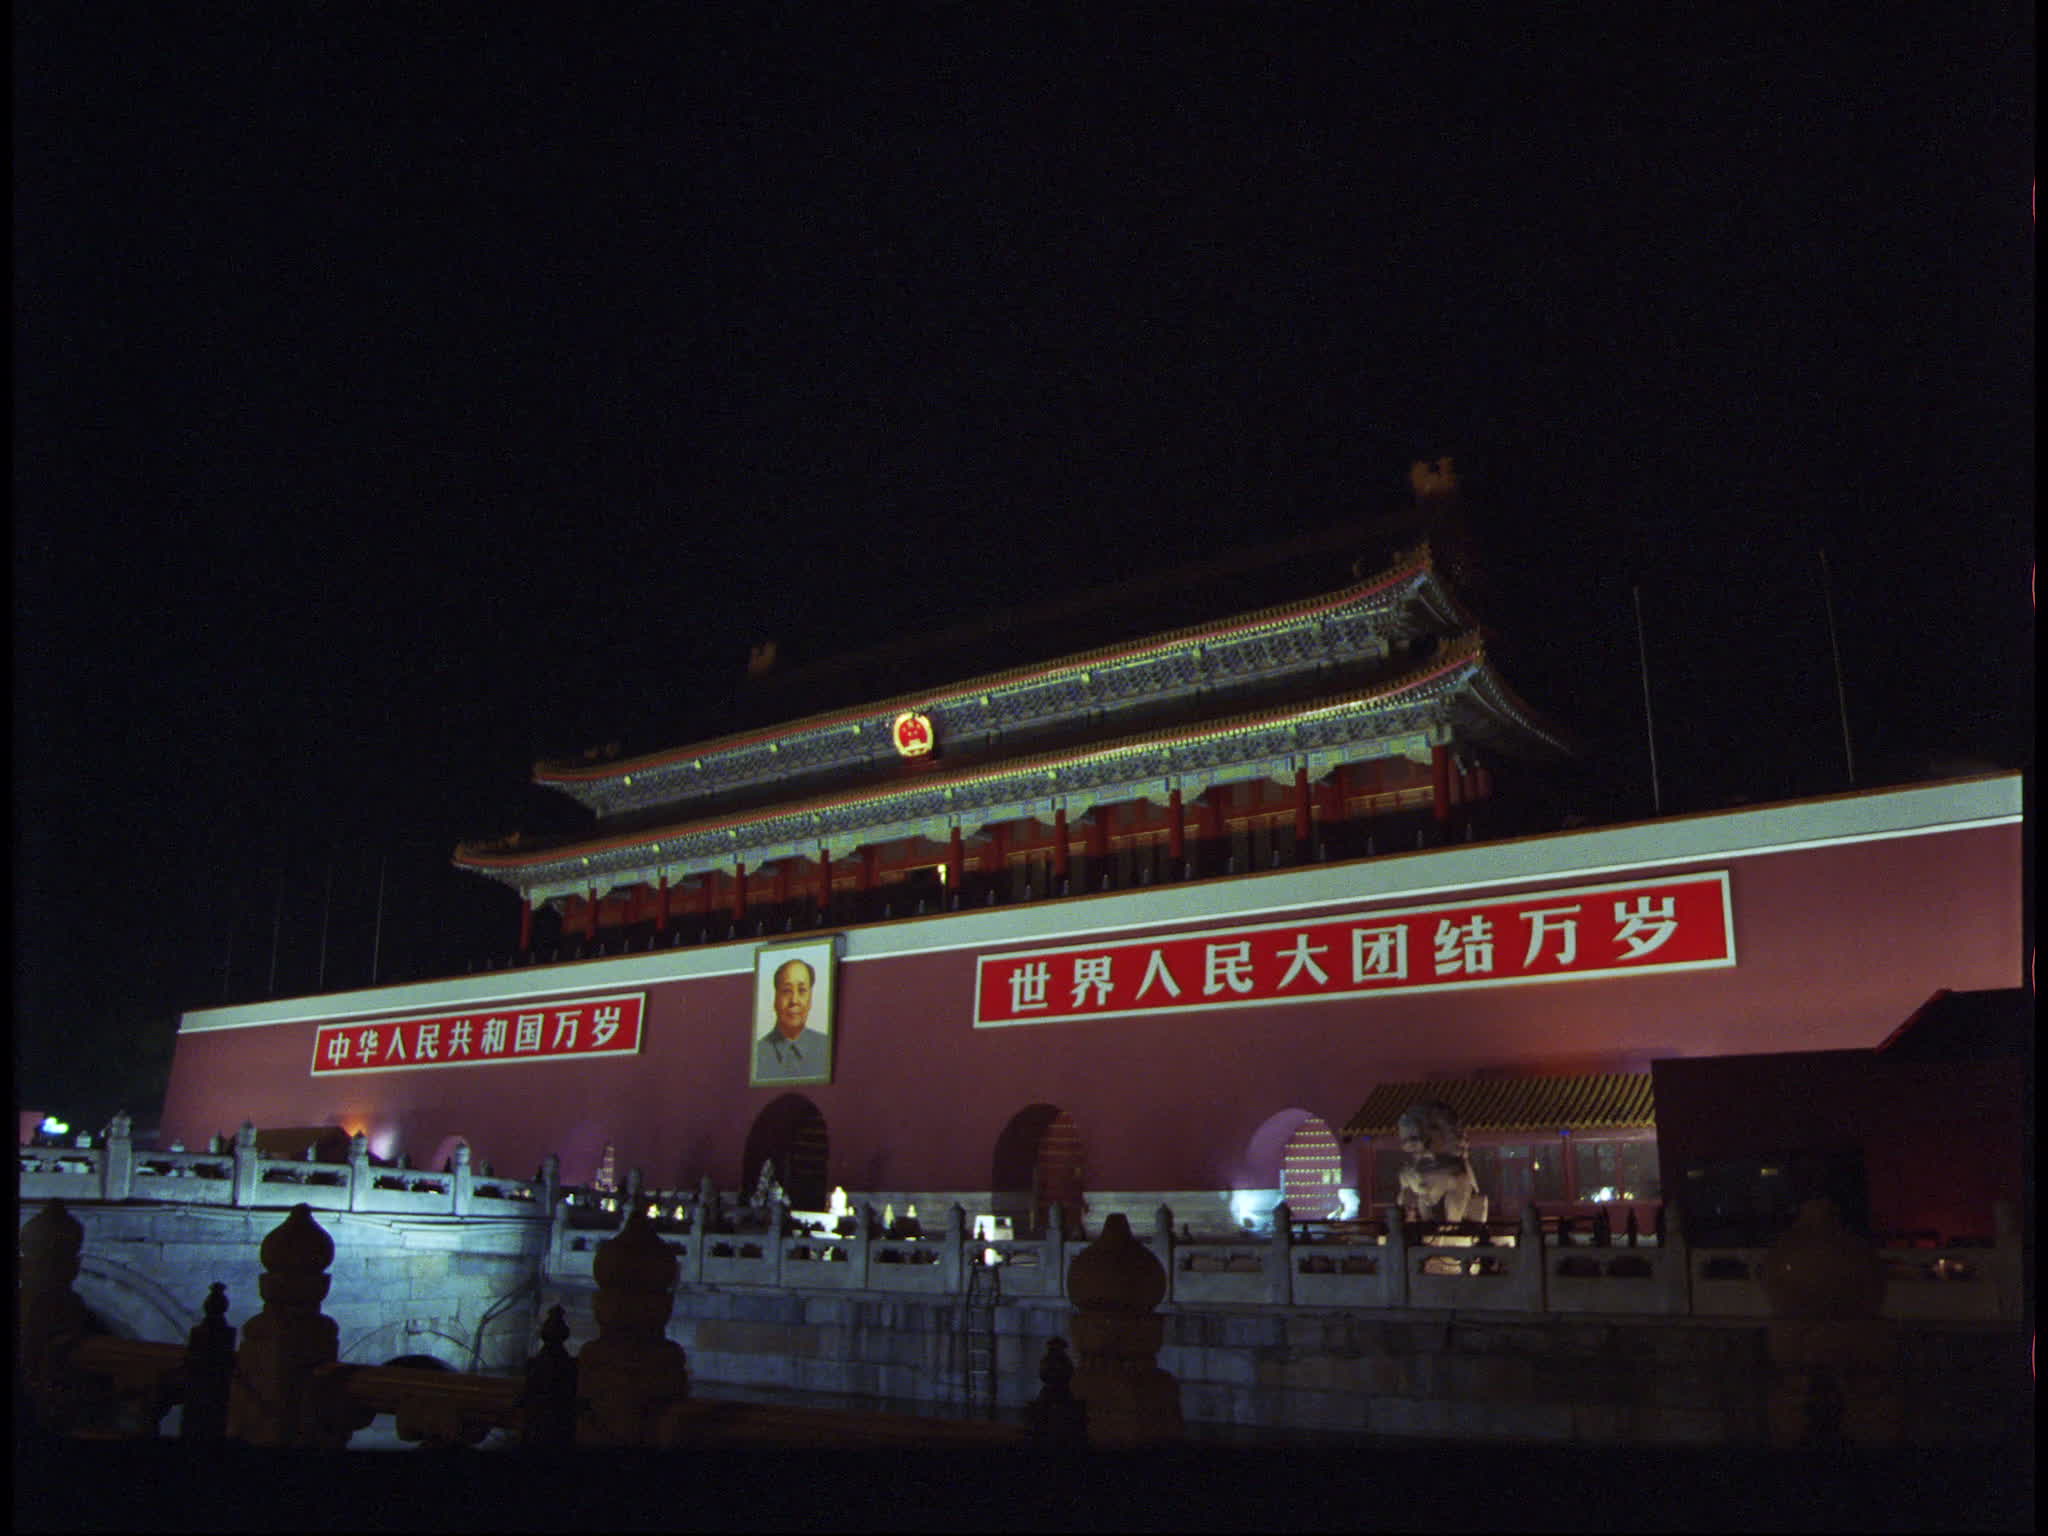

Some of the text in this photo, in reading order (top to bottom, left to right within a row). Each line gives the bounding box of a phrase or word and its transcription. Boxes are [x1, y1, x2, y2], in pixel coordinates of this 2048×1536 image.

[1008, 896, 1678, 1013] 世界人民大团结万岁
[327, 1006, 621, 1067] 中华人民共和国万岁
